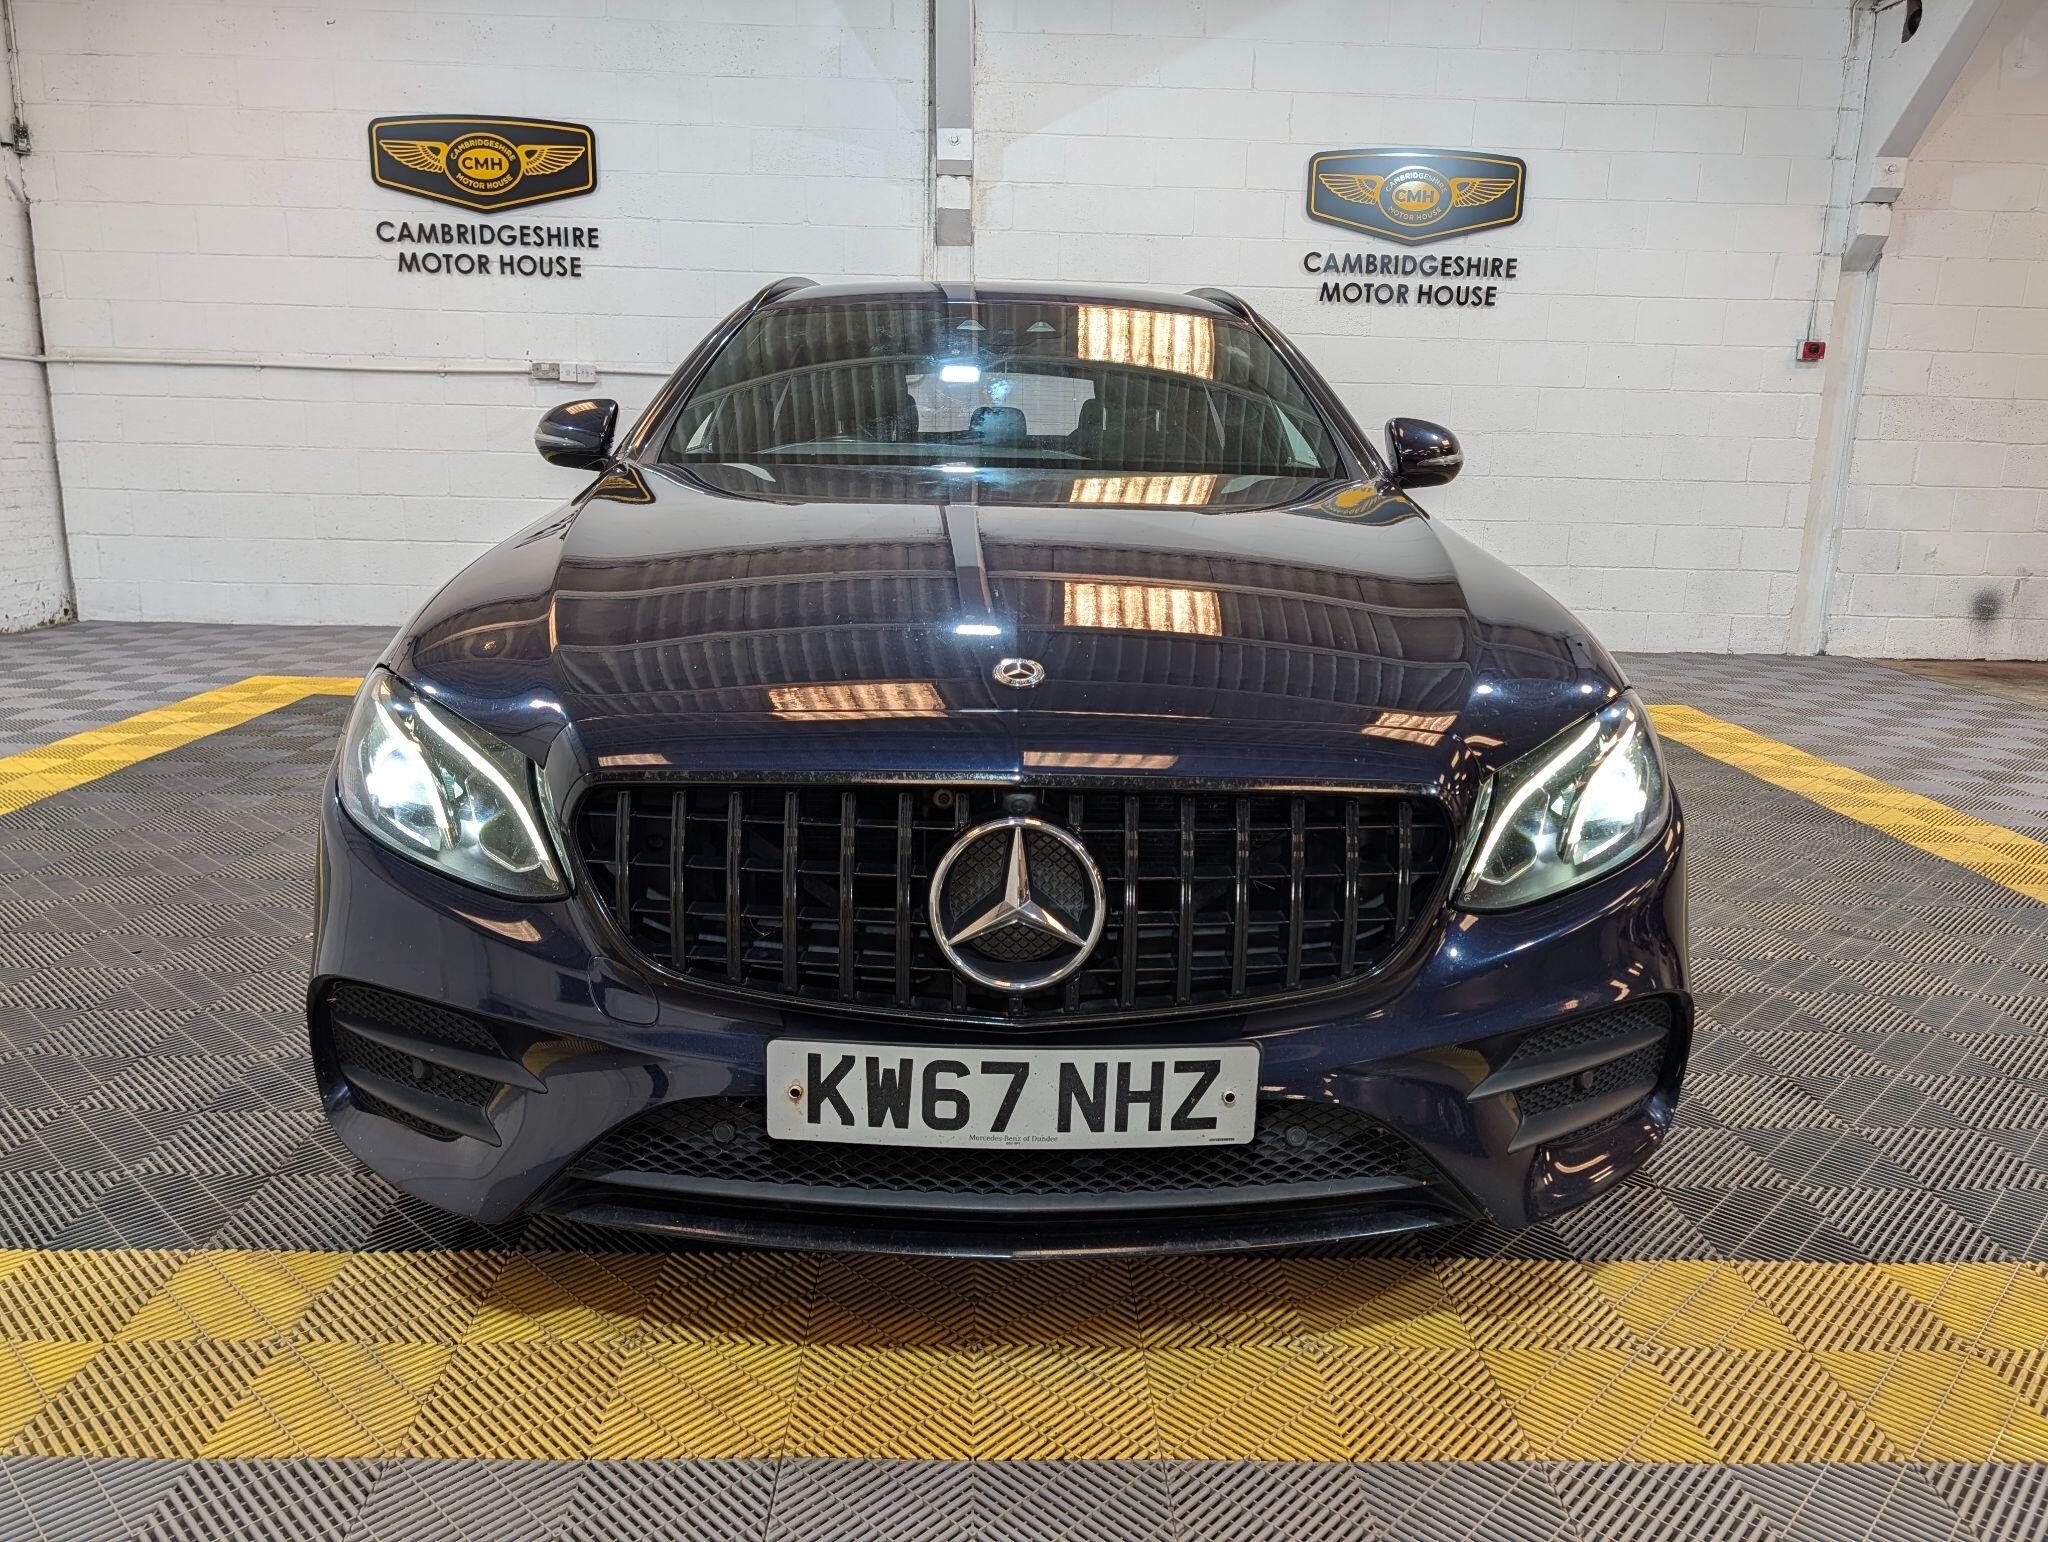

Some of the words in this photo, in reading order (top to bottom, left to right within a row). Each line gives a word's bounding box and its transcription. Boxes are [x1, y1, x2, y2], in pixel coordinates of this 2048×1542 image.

[450, 138, 516, 161] CAMBRIDGESHIRE
[462, 156, 503, 170] CMH
[456, 173, 485, 189] MOTOR
[486, 173, 513, 189] HOUSE
[1395, 189, 1434, 203] CMH
[1388, 205, 1414, 221] MOTOR
[1416, 207, 1442, 221] HOUSE
[376, 221, 600, 248] CAMBRIDGESHIRE
[398, 252, 490, 276] MOTOR
[499, 254, 582, 277] HOUSE
[1303, 251, 1518, 279] CAMBRIDGESHIRE
[1319, 281, 1409, 304] MOTOR
[1417, 284, 1498, 307] HOUSE
[806, 1052, 1031, 1133] KW67
[1056, 1059, 1222, 1133] NHZ
[968, 1134, 1022, 1142] Mercedes-Benz
